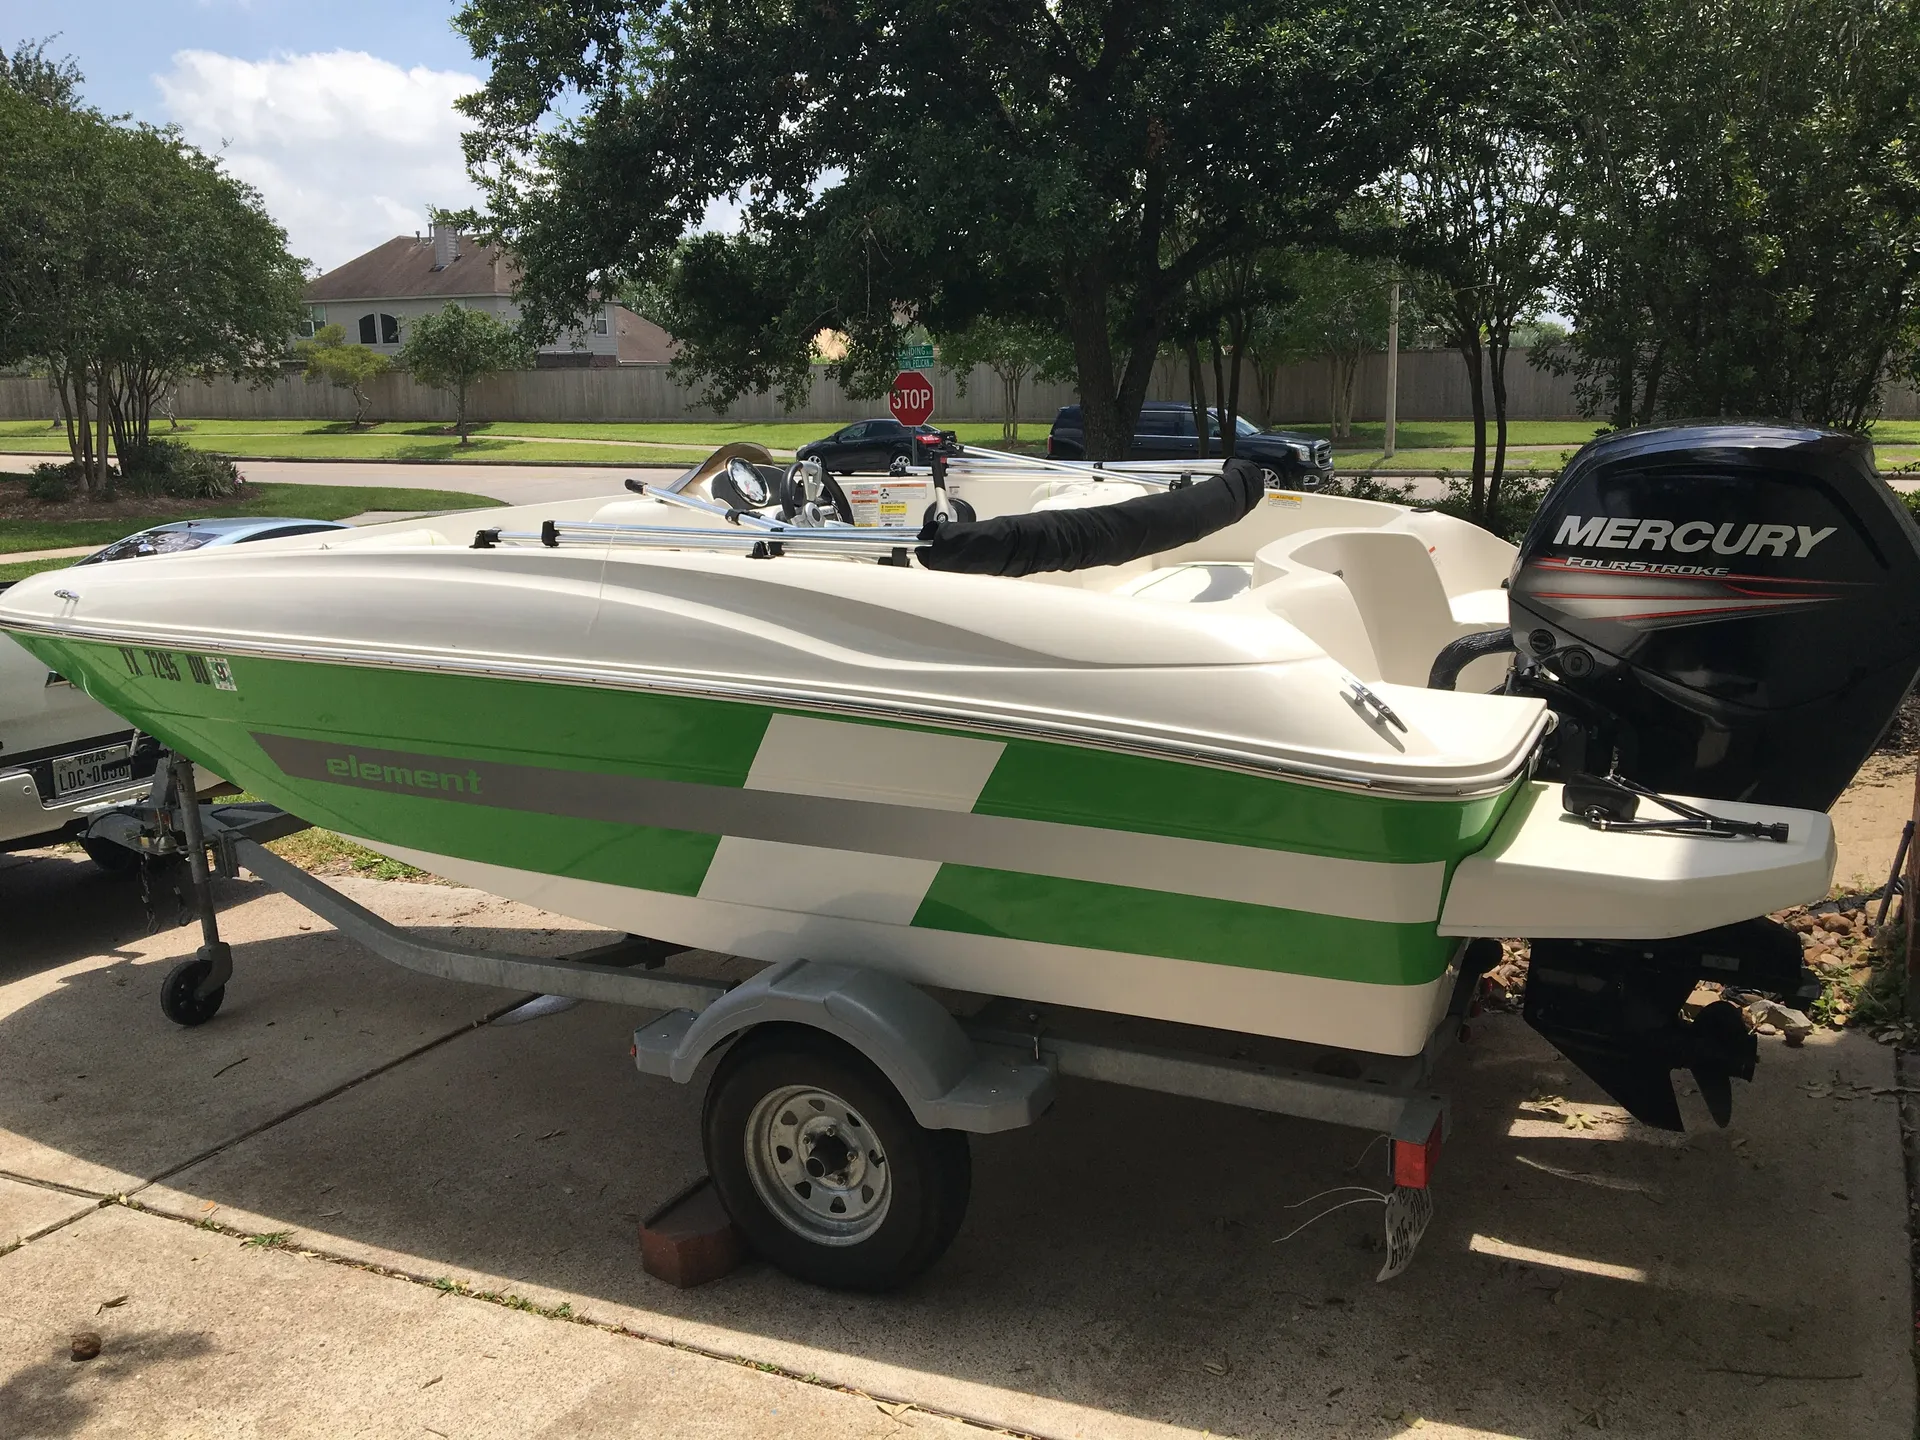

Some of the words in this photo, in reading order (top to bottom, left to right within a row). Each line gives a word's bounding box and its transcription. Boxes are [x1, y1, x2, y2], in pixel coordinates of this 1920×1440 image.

[893, 389, 931, 409] STOP
[1552, 515, 1837, 558] MERCURY
[1565, 556, 1730, 577] FOURSTROKE
[119, 647, 144, 676] TX
[143, 649, 181, 681] 7295
[77, 752, 106, 766] TEXAS
[326, 754, 483, 794] element
